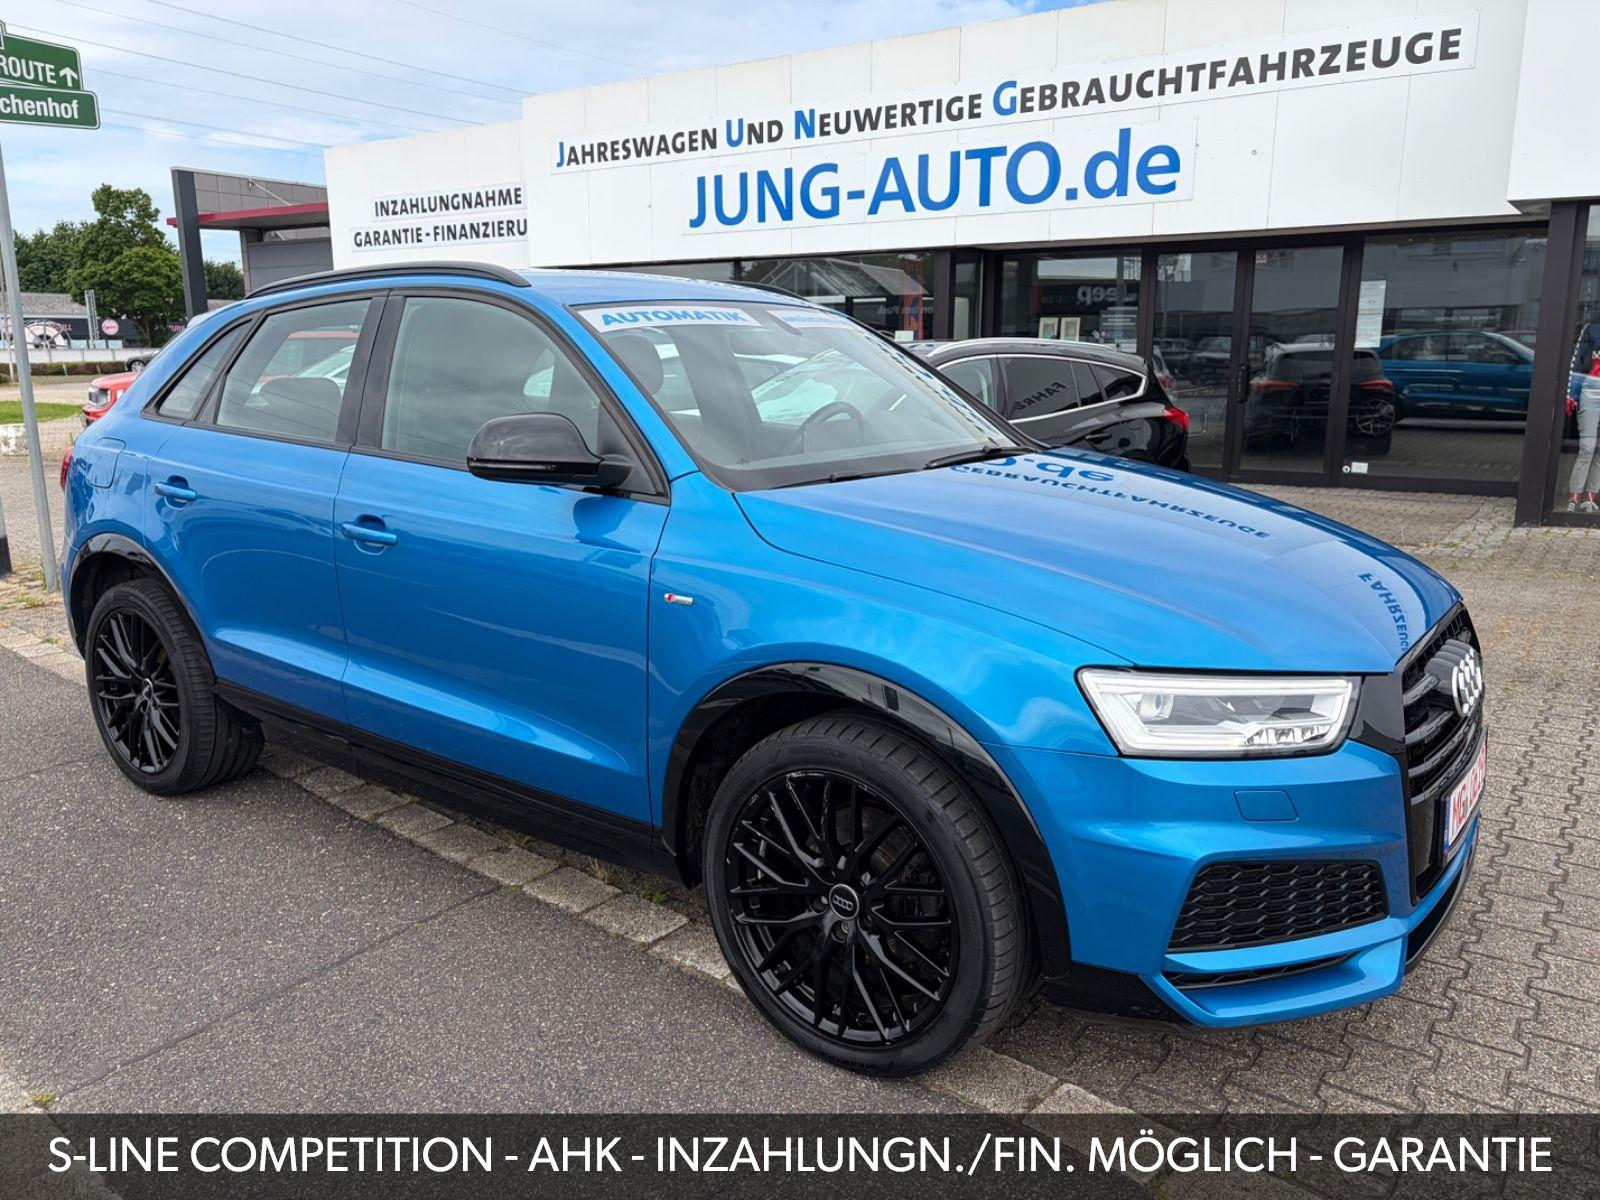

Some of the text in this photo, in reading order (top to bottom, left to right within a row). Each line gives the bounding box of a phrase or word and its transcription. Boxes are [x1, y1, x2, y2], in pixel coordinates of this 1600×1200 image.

[556, 28, 1462, 168] JAHRESWAGEN UND NEUWERTIGE GEBRAUCHTFAHRZEUGE
[374, 187, 522, 217] INZAHLUNGNAHME
[689, 127, 1181, 228] JUNG-AUTO.de
[601, 309, 747, 327] AUTOMATIK
